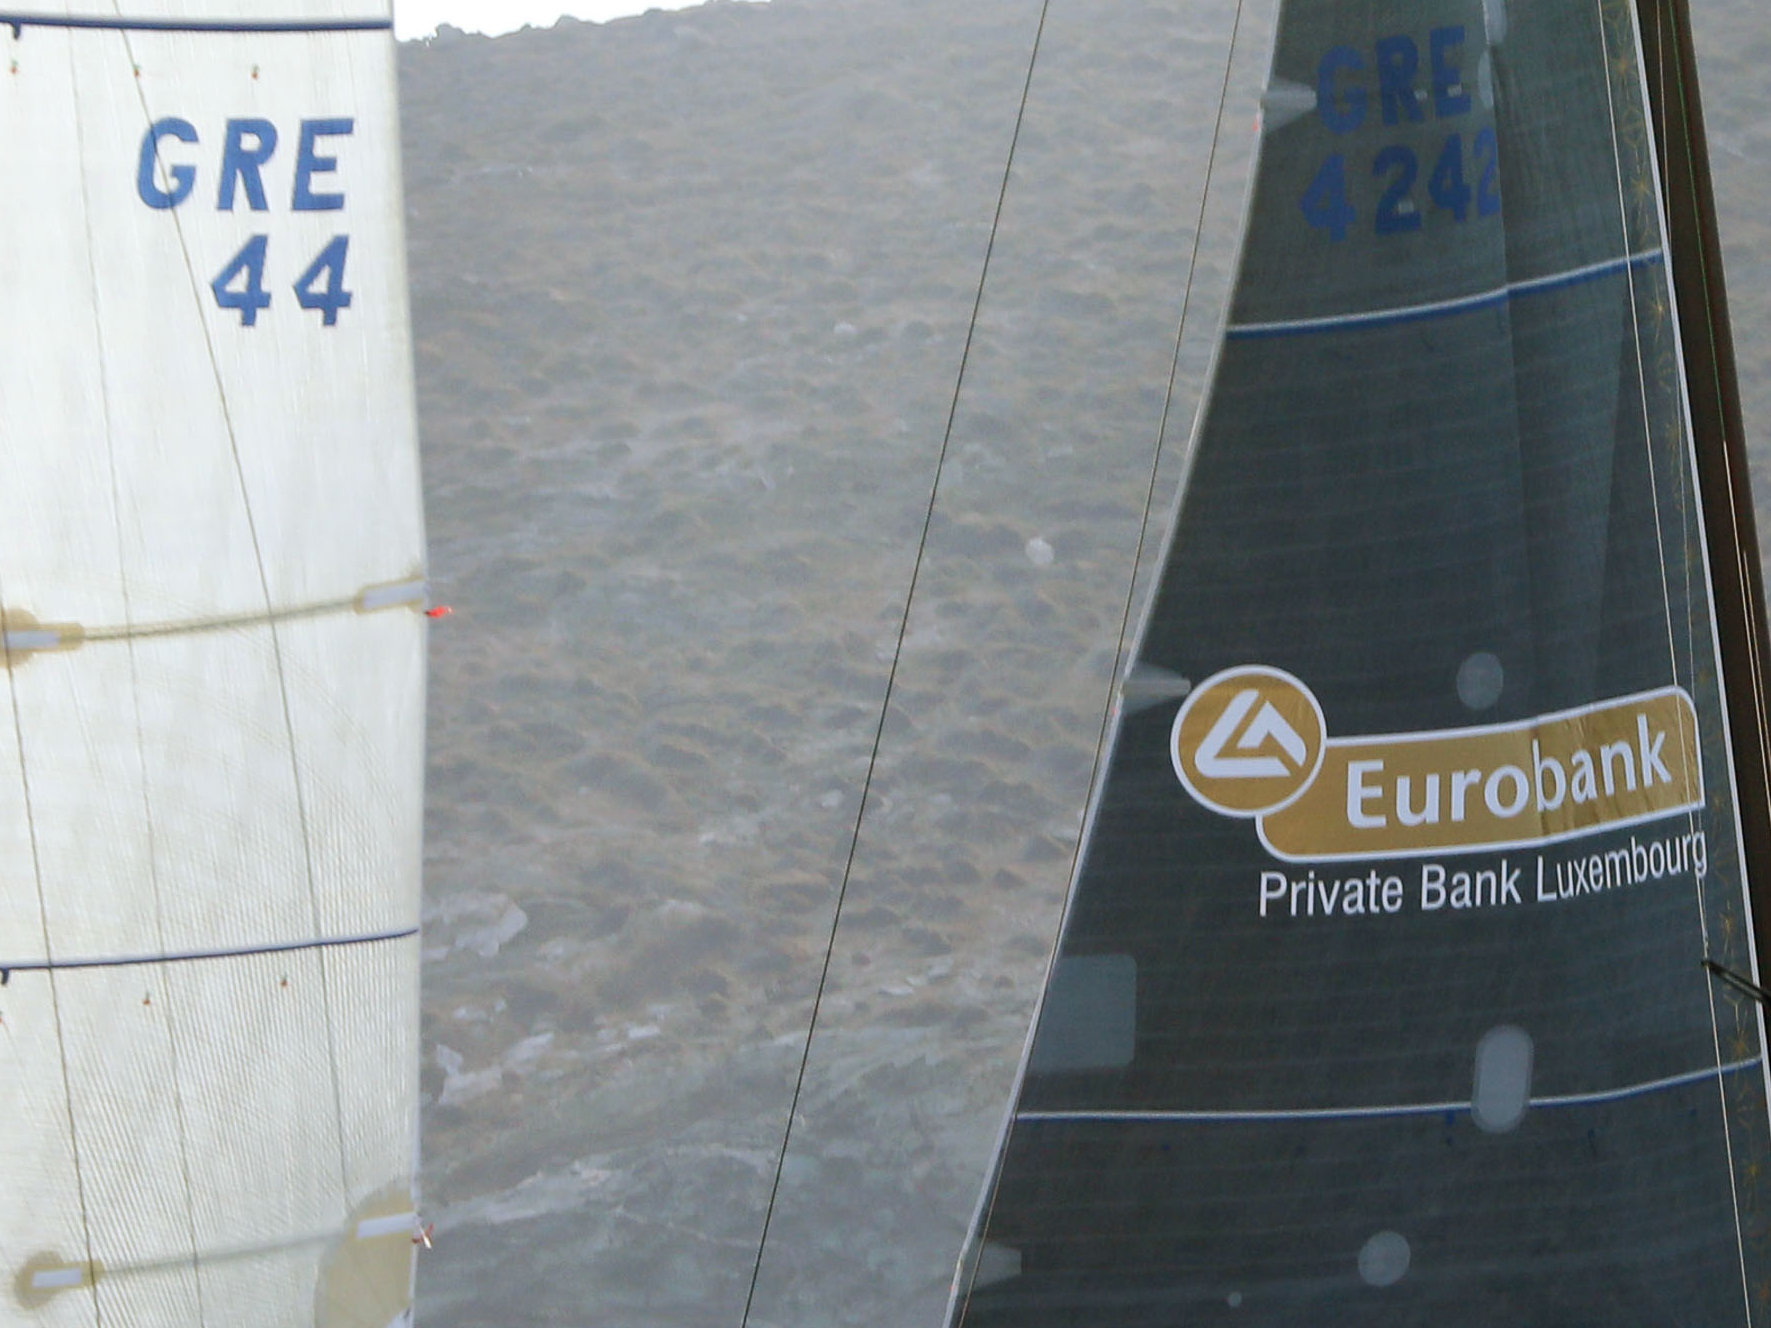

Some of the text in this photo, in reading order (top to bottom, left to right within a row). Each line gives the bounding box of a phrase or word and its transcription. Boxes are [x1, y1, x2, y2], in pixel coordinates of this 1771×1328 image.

[1316, 25, 1472, 136] GRE
[136, 117, 354, 211] GRE
[211, 234, 352, 327] 44
[1344, 713, 1672, 829] Eurobank
[1259, 829, 1708, 917] Private Bank Luxembourg
